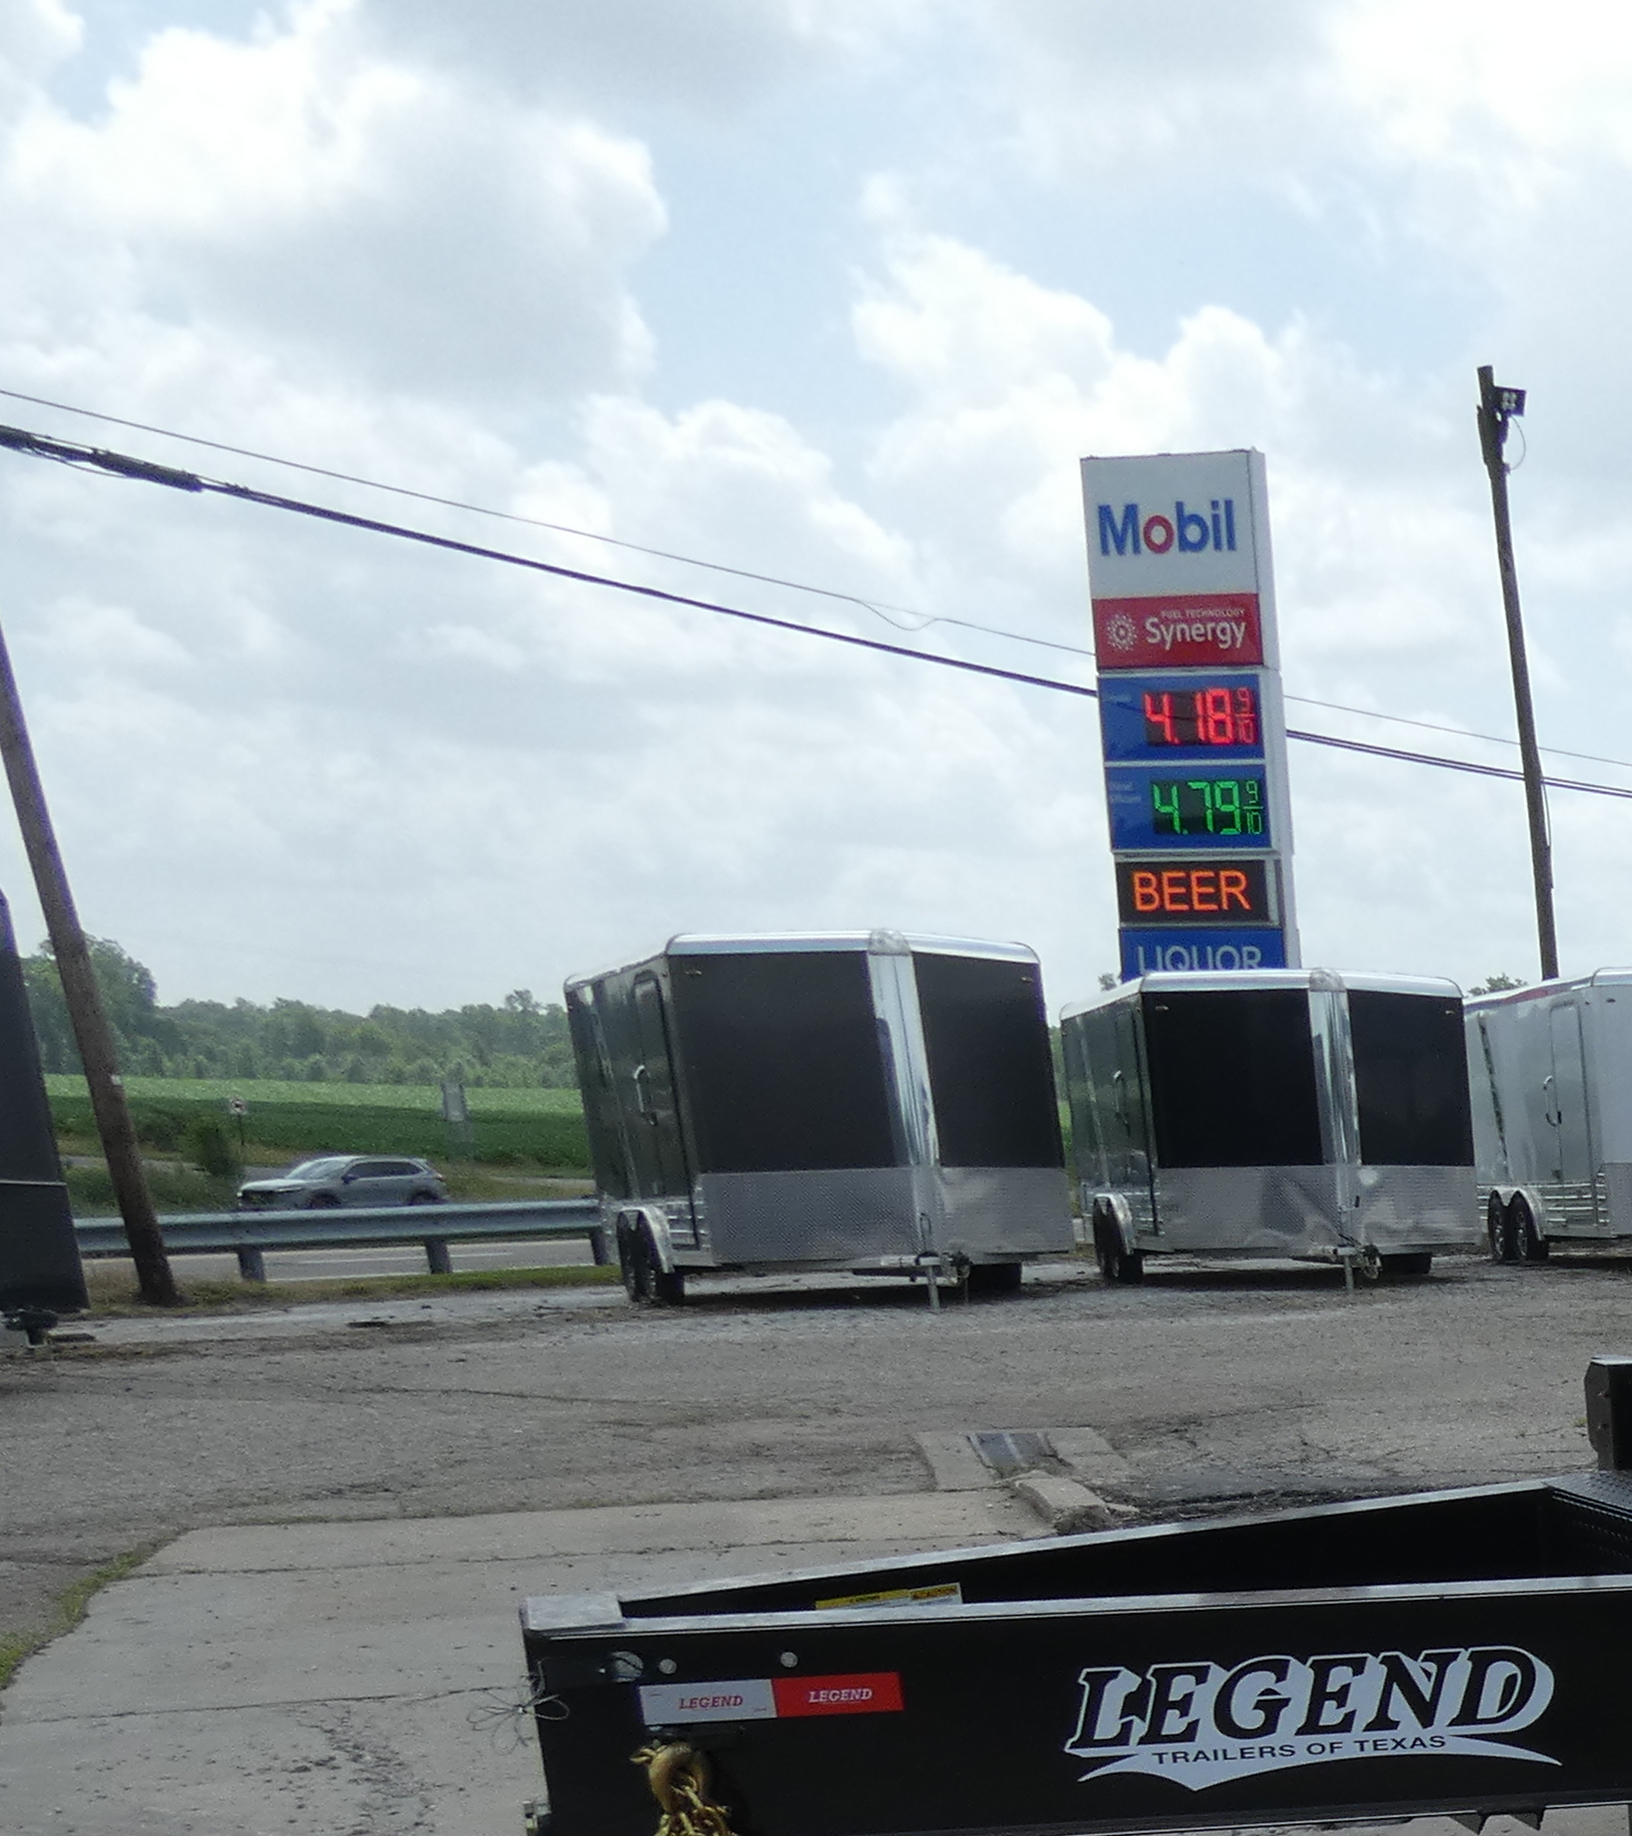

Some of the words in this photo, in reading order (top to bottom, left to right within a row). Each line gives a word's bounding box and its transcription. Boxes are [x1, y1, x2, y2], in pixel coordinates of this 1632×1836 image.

[1098, 499, 1236, 556] Mobil
[1161, 609, 1183, 619] FUEL
[1186, 608, 1246, 618] TECHNOLOGY
[1145, 617, 1247, 650] Synergy
[1152, 781, 1242, 834] 4.79
[1132, 869, 1251, 911] BEER
[1138, 945, 1262, 974] LIQUOR
[679, 1695, 743, 1710] LEGEND
[808, 1687, 873, 1703] LEGEND
[1065, 1645, 1554, 1757] LEGEND
[1152, 1744, 1296, 1765] TRAILERS
[1306, 1741, 1343, 1756] OF
[1353, 1735, 1447, 1753] TEXAS
